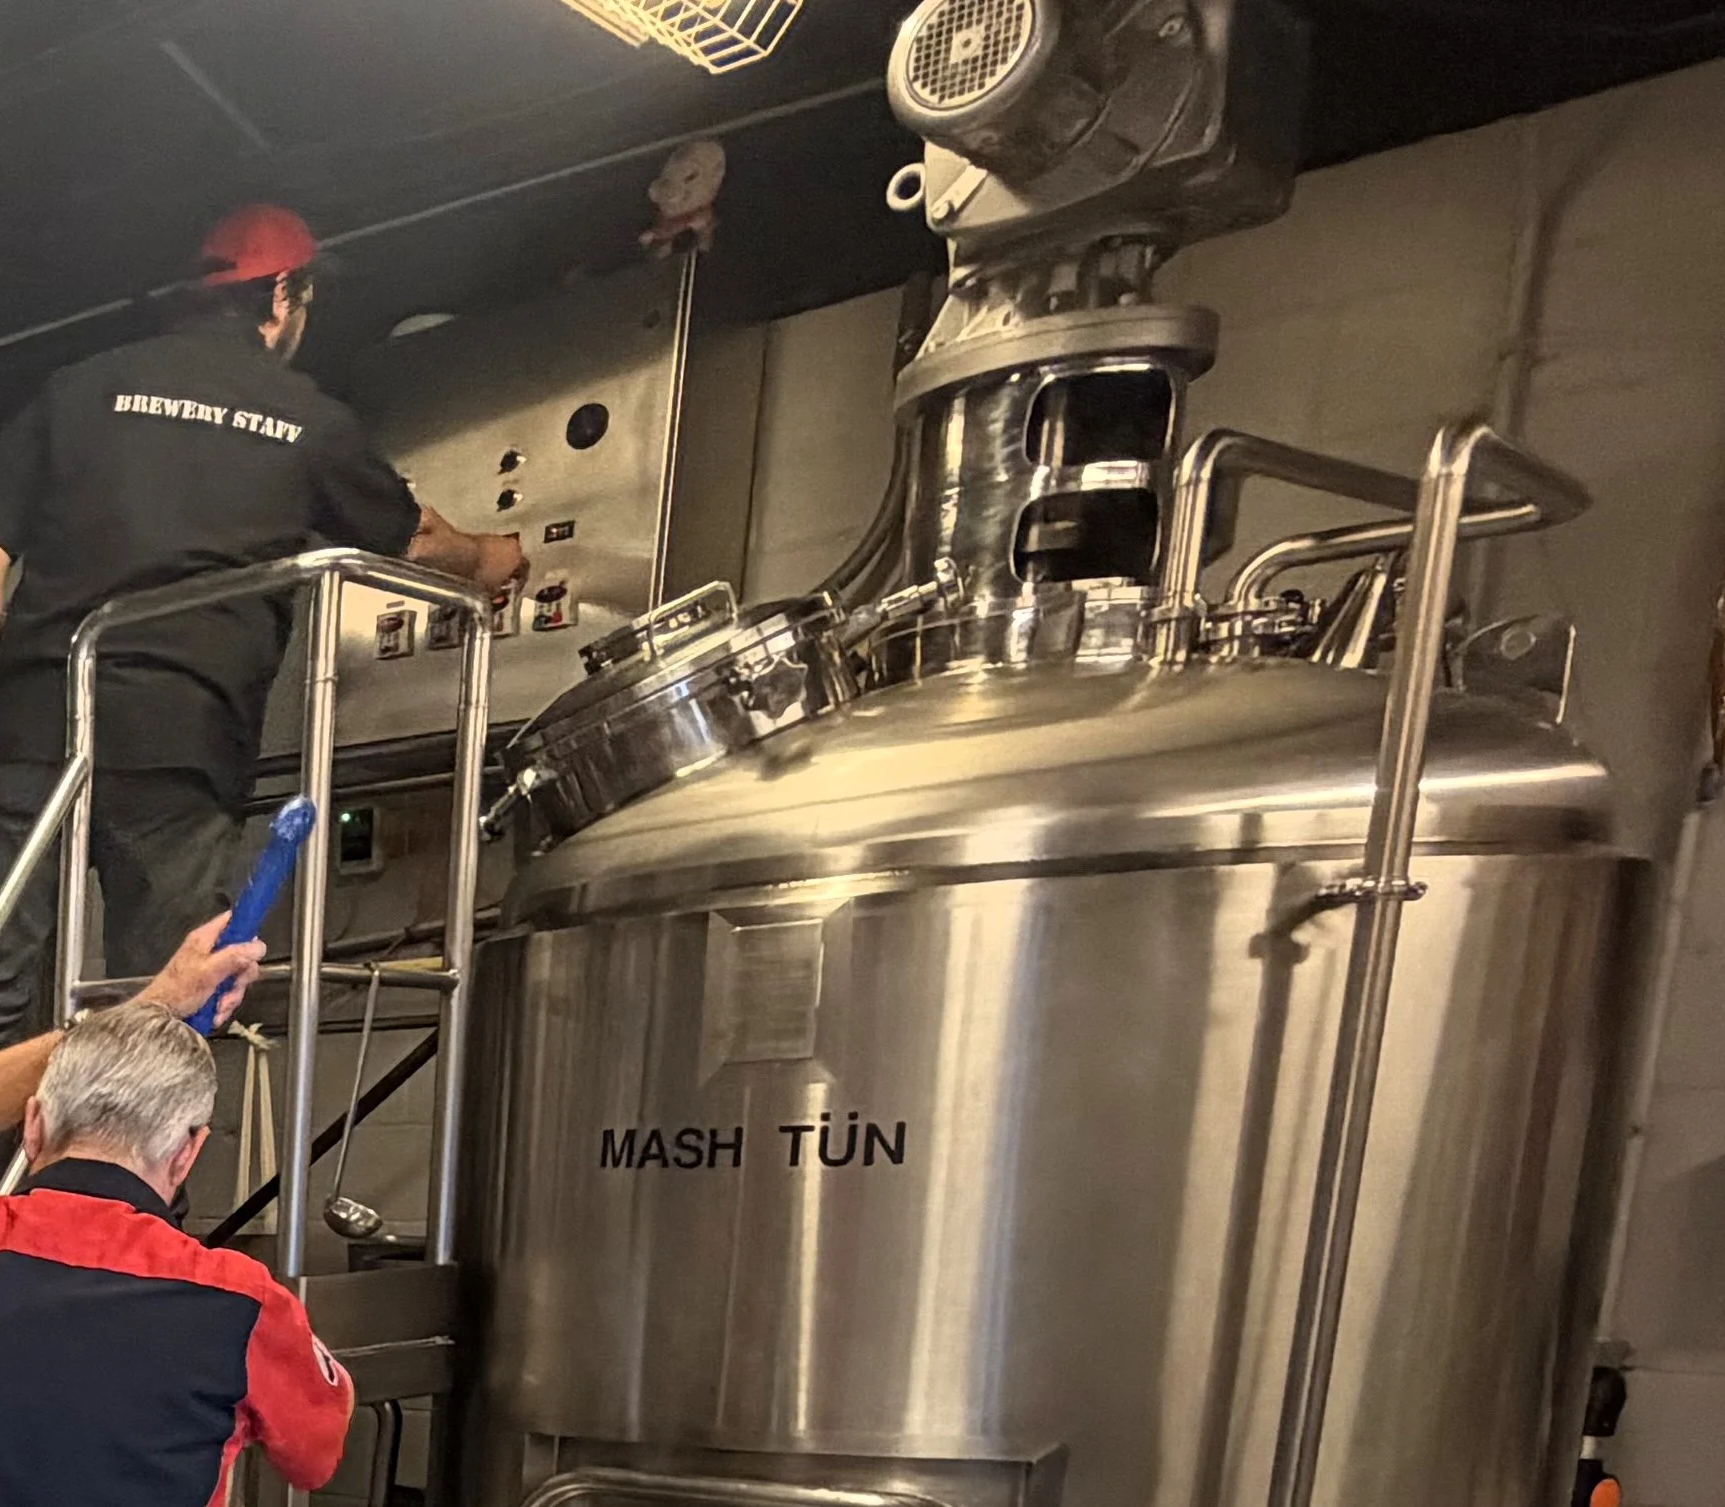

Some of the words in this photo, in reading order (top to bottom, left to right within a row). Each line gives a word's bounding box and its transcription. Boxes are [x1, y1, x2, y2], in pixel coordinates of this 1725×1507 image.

[114, 394, 228, 425] BREWERY
[232, 411, 302, 443] STAFF
[600, 1127, 743, 1168] MASH
[779, 1111, 906, 1167] TÜN
